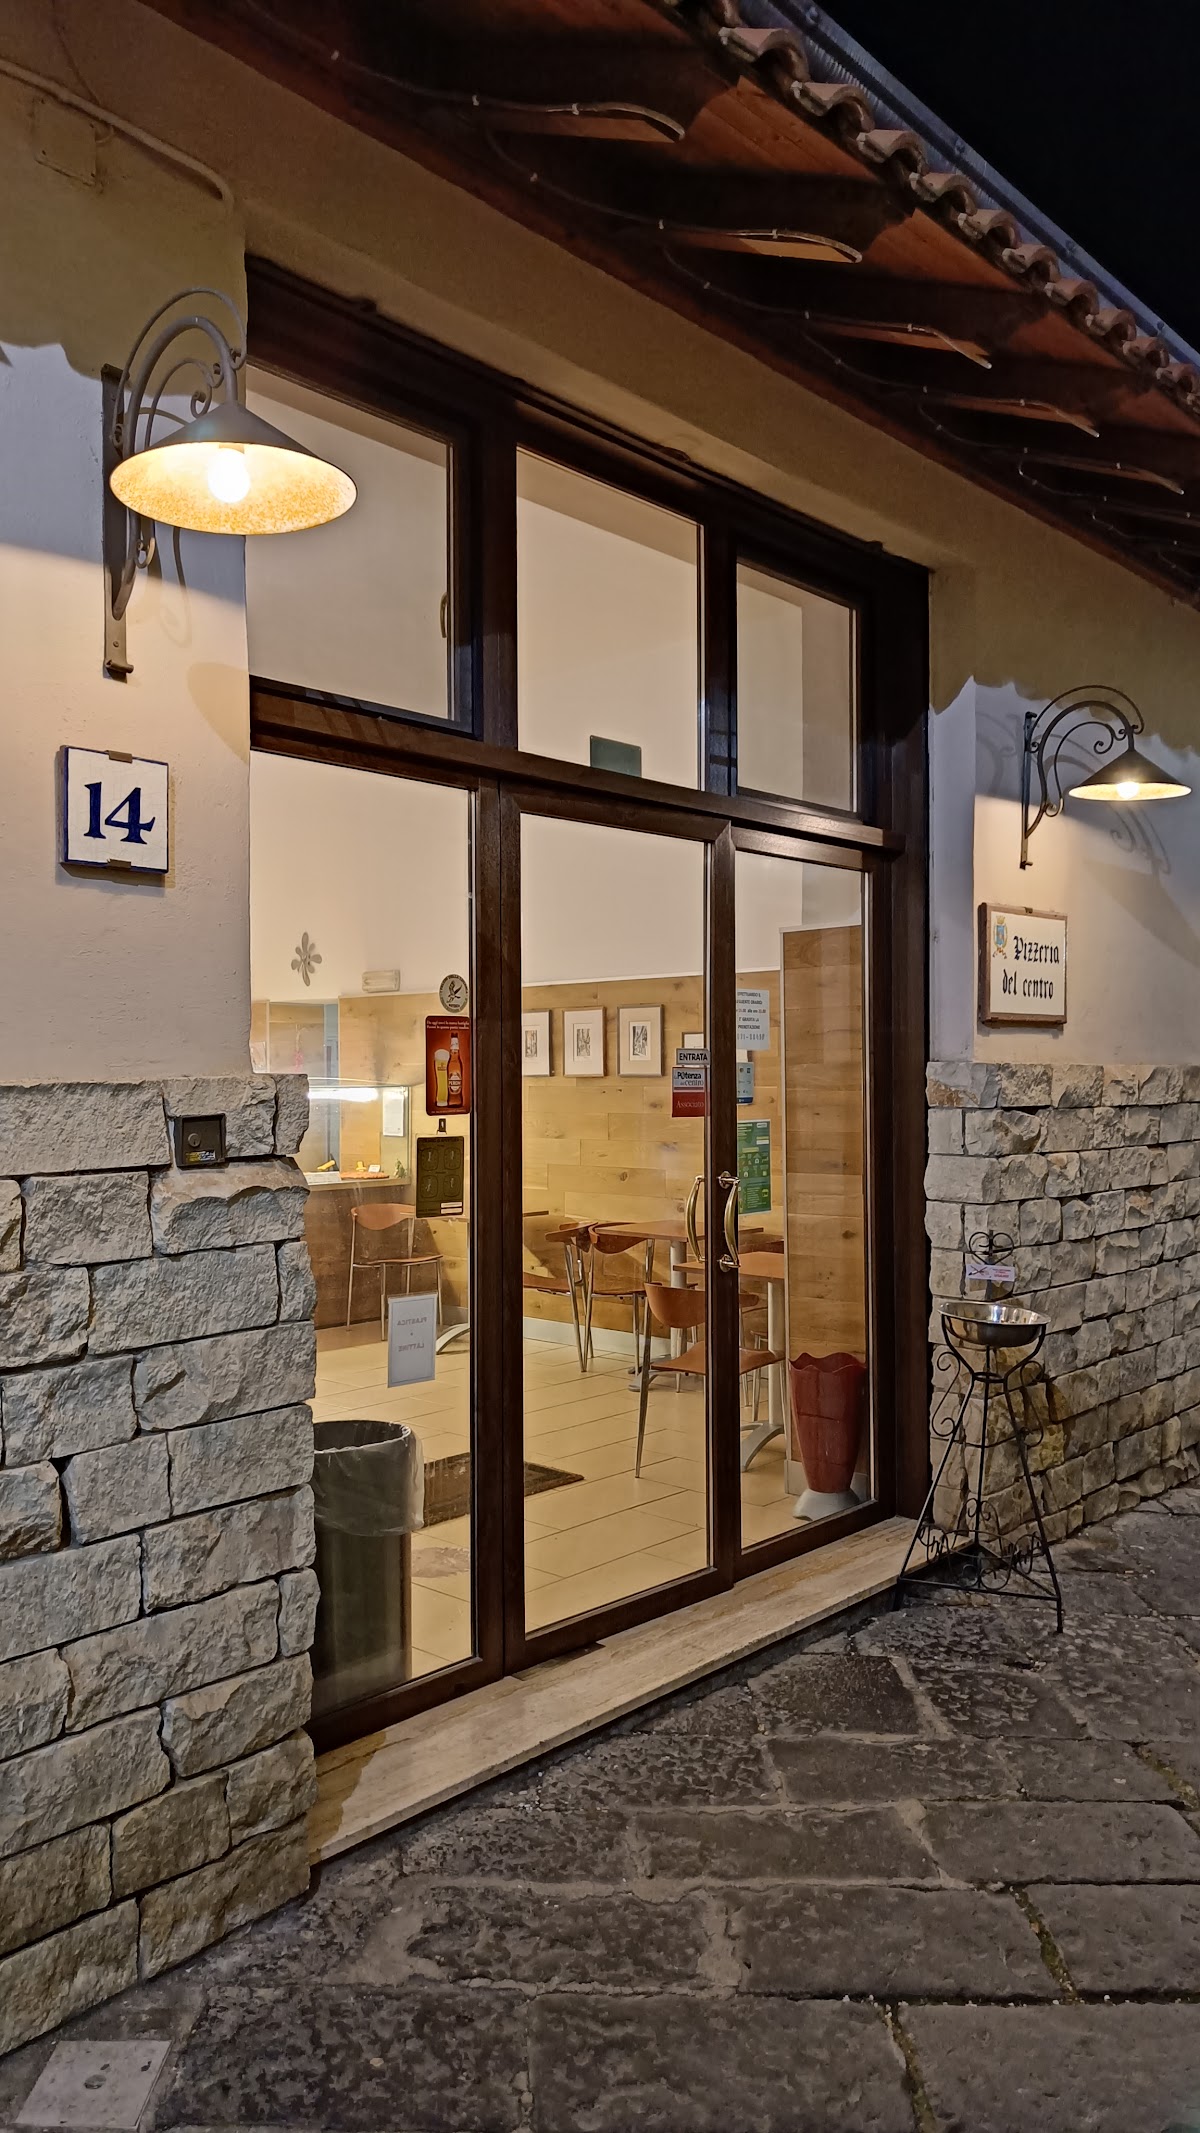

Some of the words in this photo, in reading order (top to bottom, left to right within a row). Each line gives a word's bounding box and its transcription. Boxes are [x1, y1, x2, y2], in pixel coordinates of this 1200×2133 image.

[83, 781, 156, 845] 14
[1013, 935, 1060, 964] Pizzeria
[1002, 969, 1017, 996] del
[1022, 977, 1054, 999] centro
[679, 1052, 708, 1061] ENTRATA
